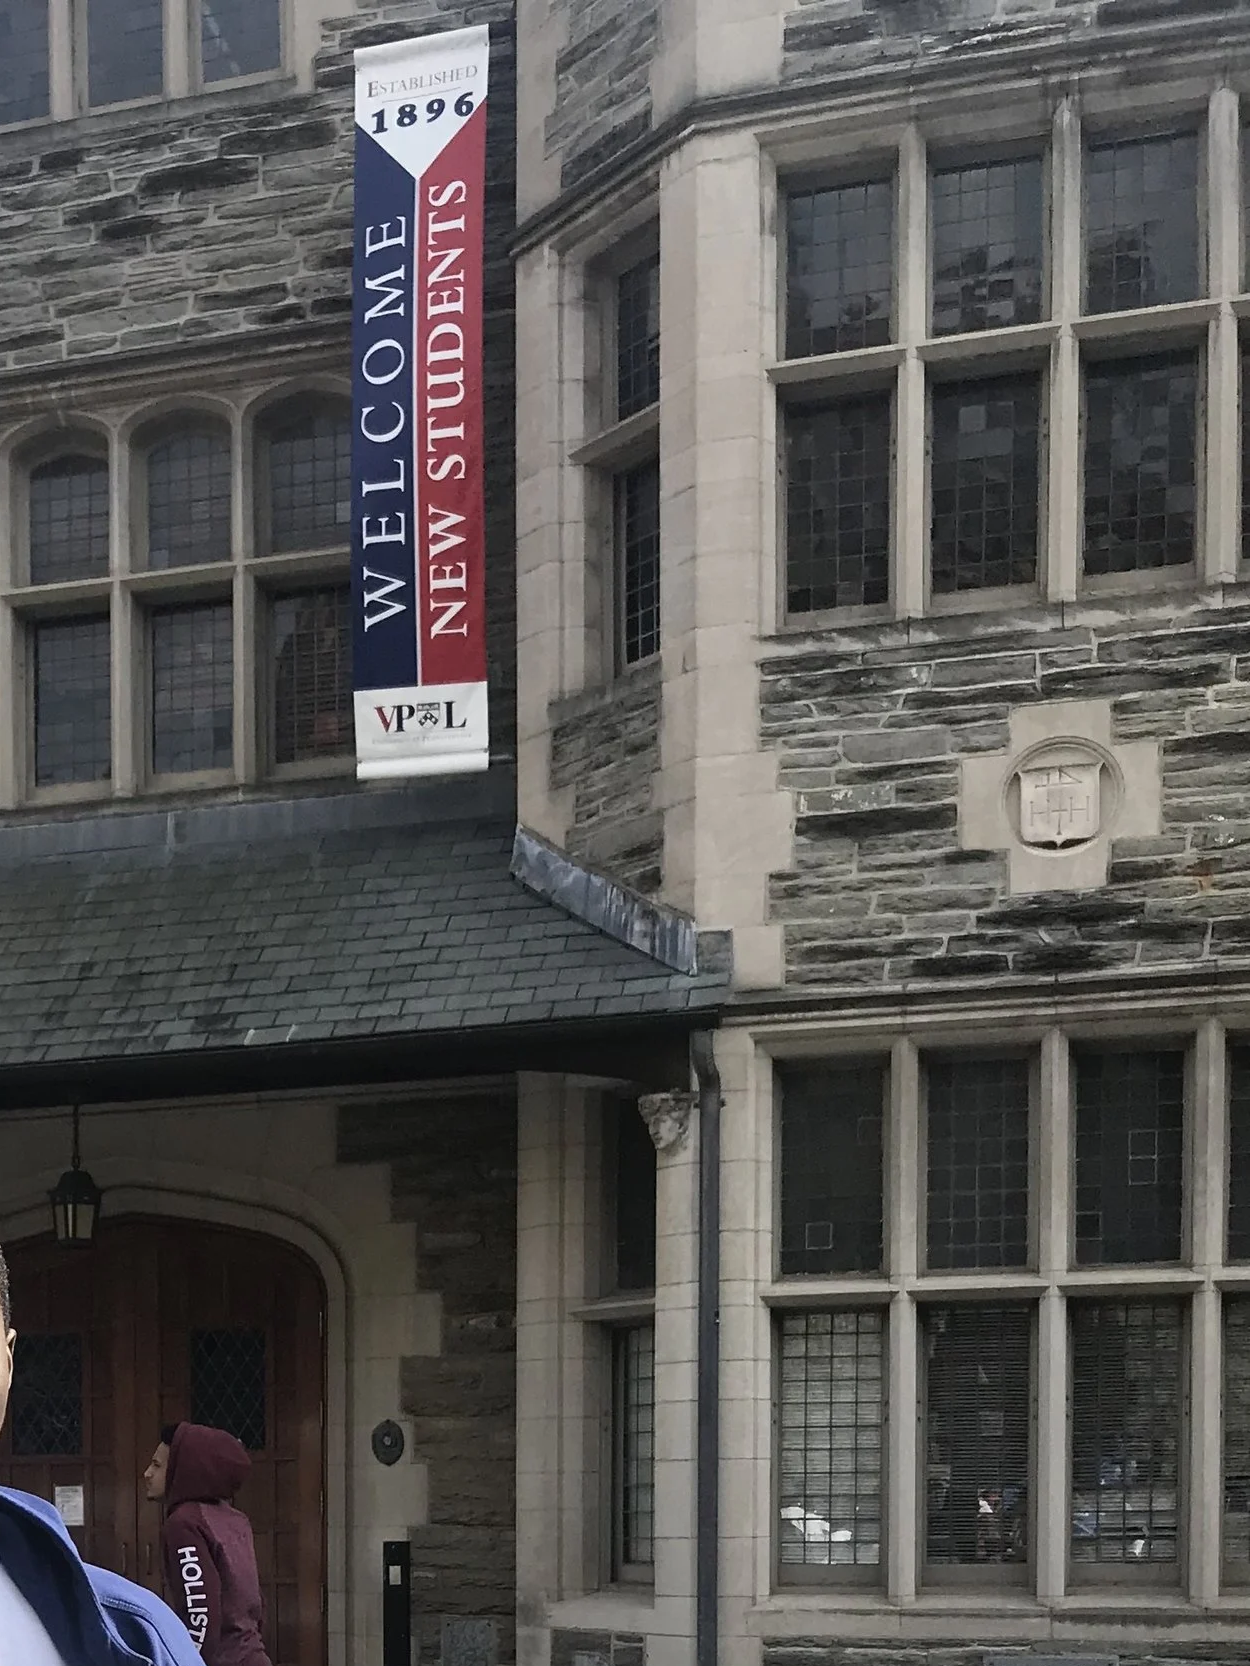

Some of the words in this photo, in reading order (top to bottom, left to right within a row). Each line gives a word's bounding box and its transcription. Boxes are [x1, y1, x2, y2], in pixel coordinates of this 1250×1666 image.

[367, 64, 478, 98] ESTABLISHED
[371, 91, 475, 135] 1896
[427, 180, 466, 481] STUDENTS
[361, 216, 407, 633] WELCOME
[427, 503, 467, 639] NEW
